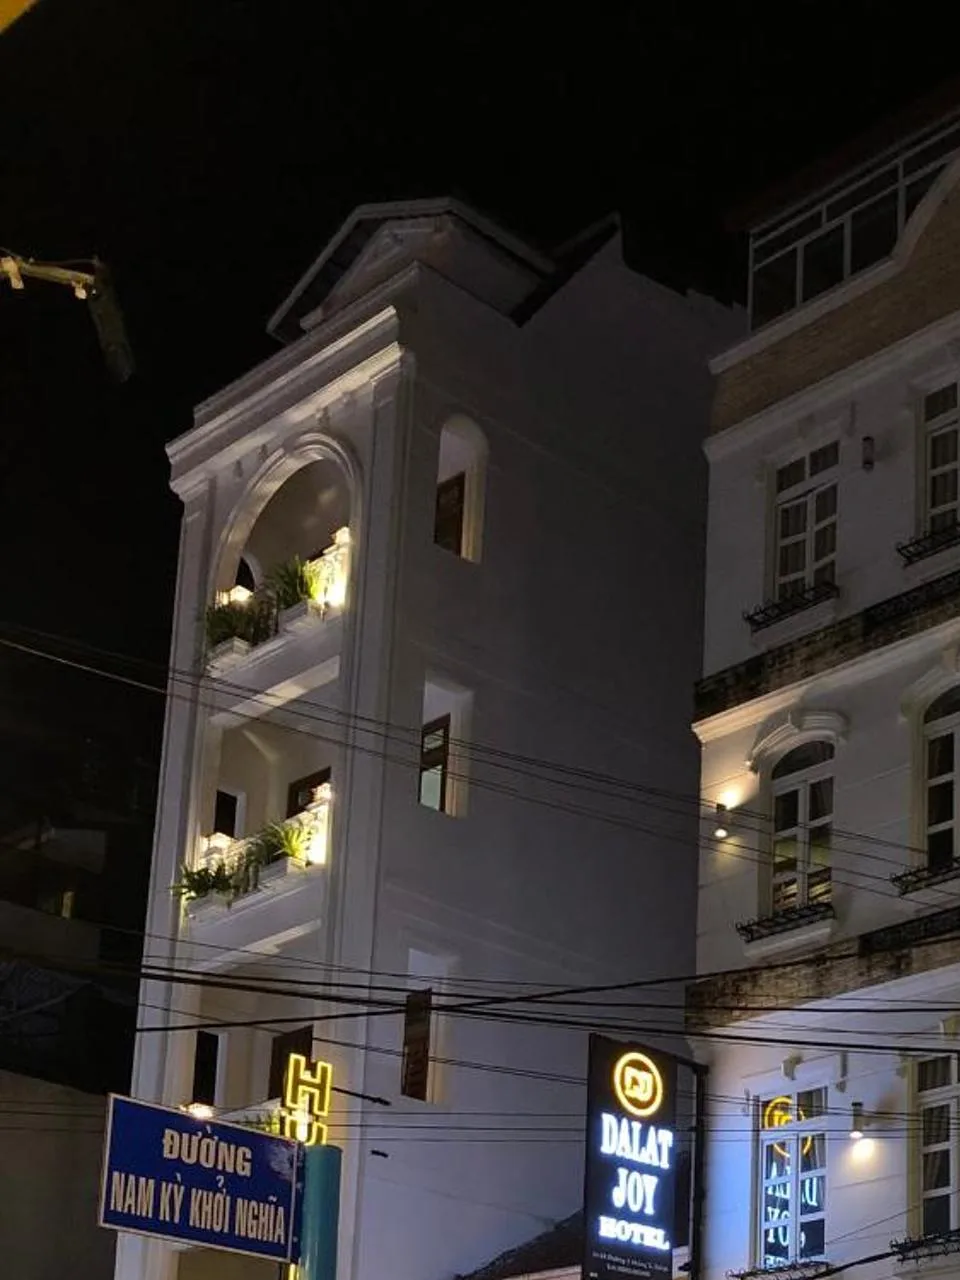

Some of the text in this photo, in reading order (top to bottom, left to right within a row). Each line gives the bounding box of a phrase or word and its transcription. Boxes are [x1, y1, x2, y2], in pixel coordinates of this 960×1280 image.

[162, 1126, 253, 1178] ĐƯỜNG
[600, 1112, 673, 1169] DALAT
[110, 1170, 286, 1245] NAM KỲ KHỞI NGHĨA
[612, 1167, 659, 1215] JOY
[598, 1215, 670, 1251] HOTEL
